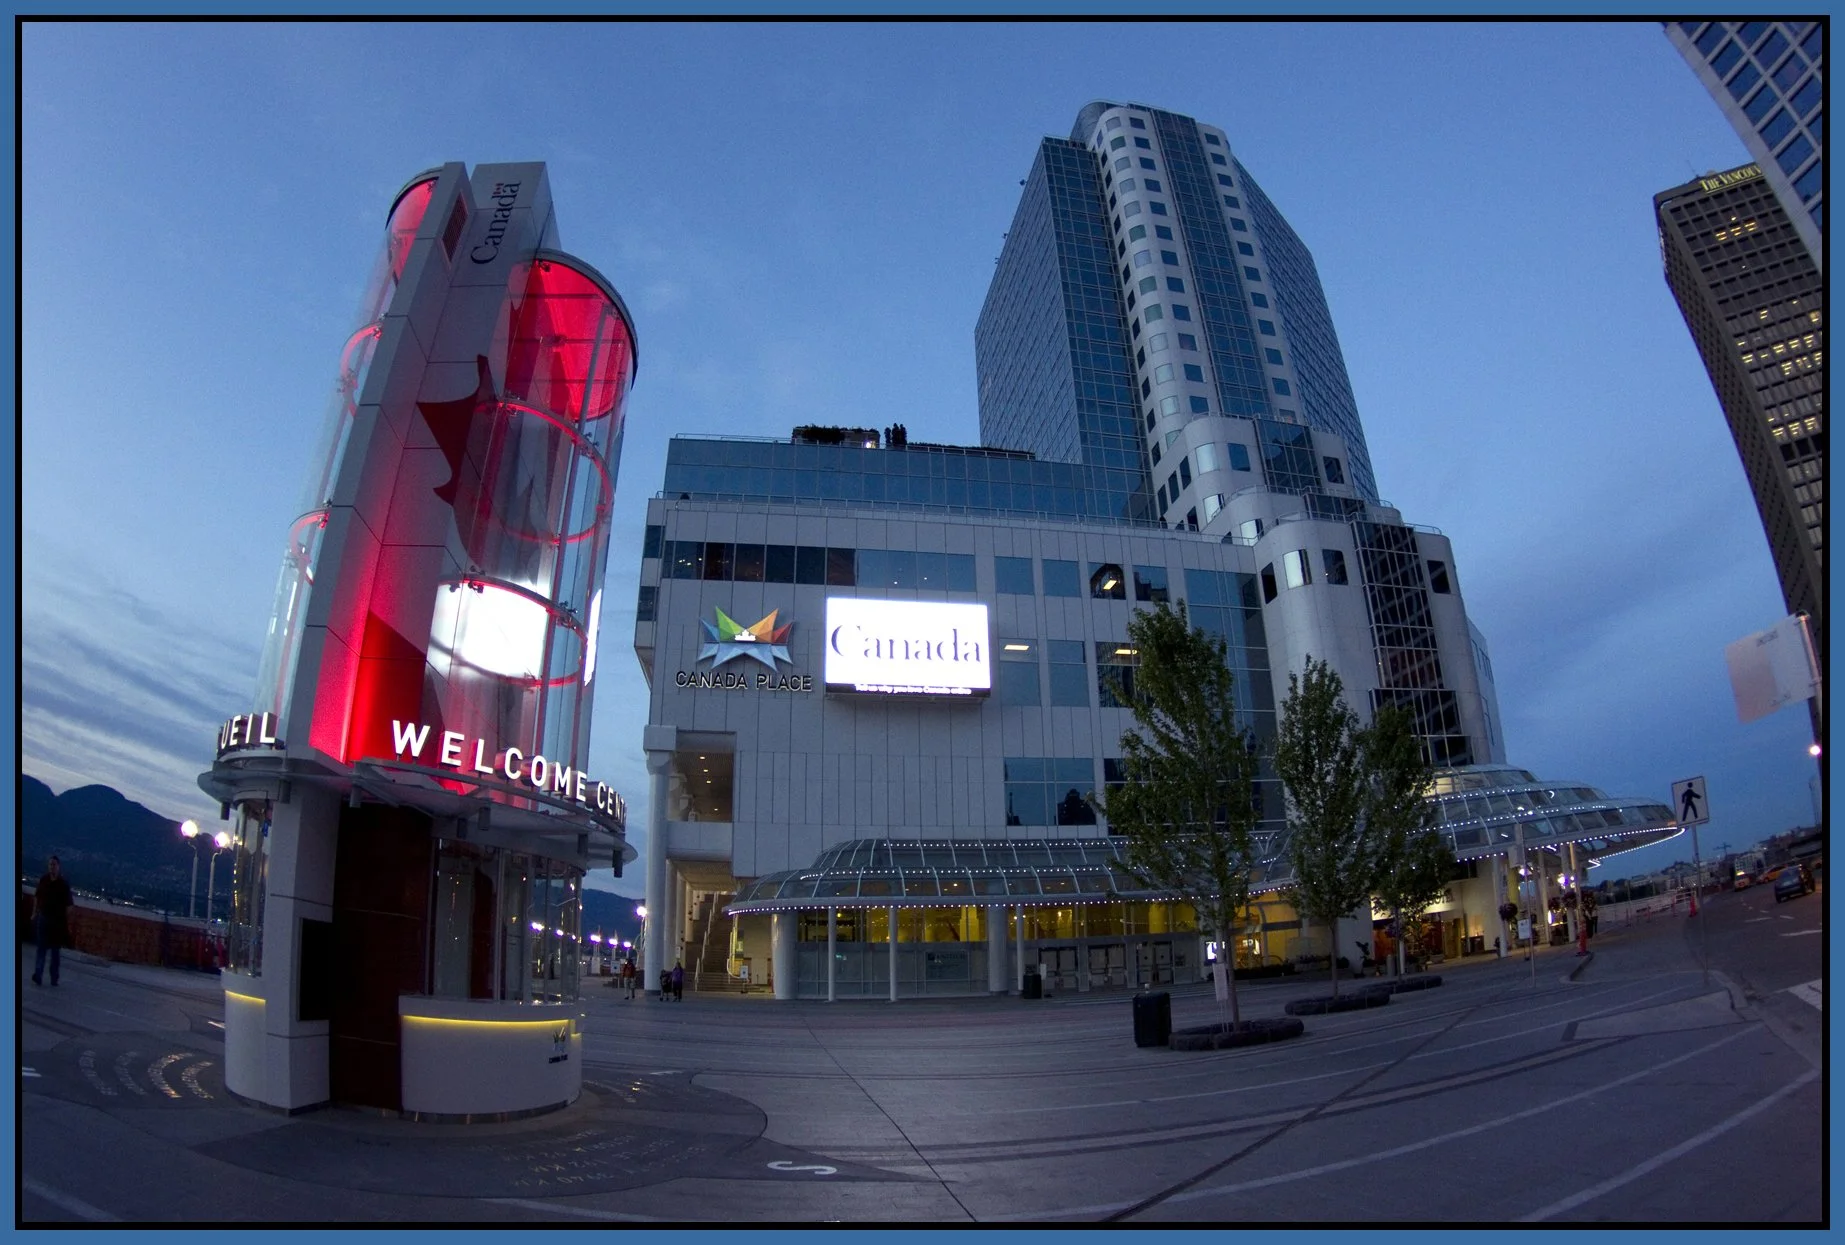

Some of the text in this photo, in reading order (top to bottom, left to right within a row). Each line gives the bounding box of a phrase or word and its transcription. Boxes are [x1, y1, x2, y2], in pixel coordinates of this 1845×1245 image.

[471, 182, 521, 264] Canada
[830, 624, 981, 663] Canada
[675, 671, 813, 693] CANADA PLACE
[219, 711, 276, 751] UEIL
[392, 719, 627, 824] WELCOME CENT
